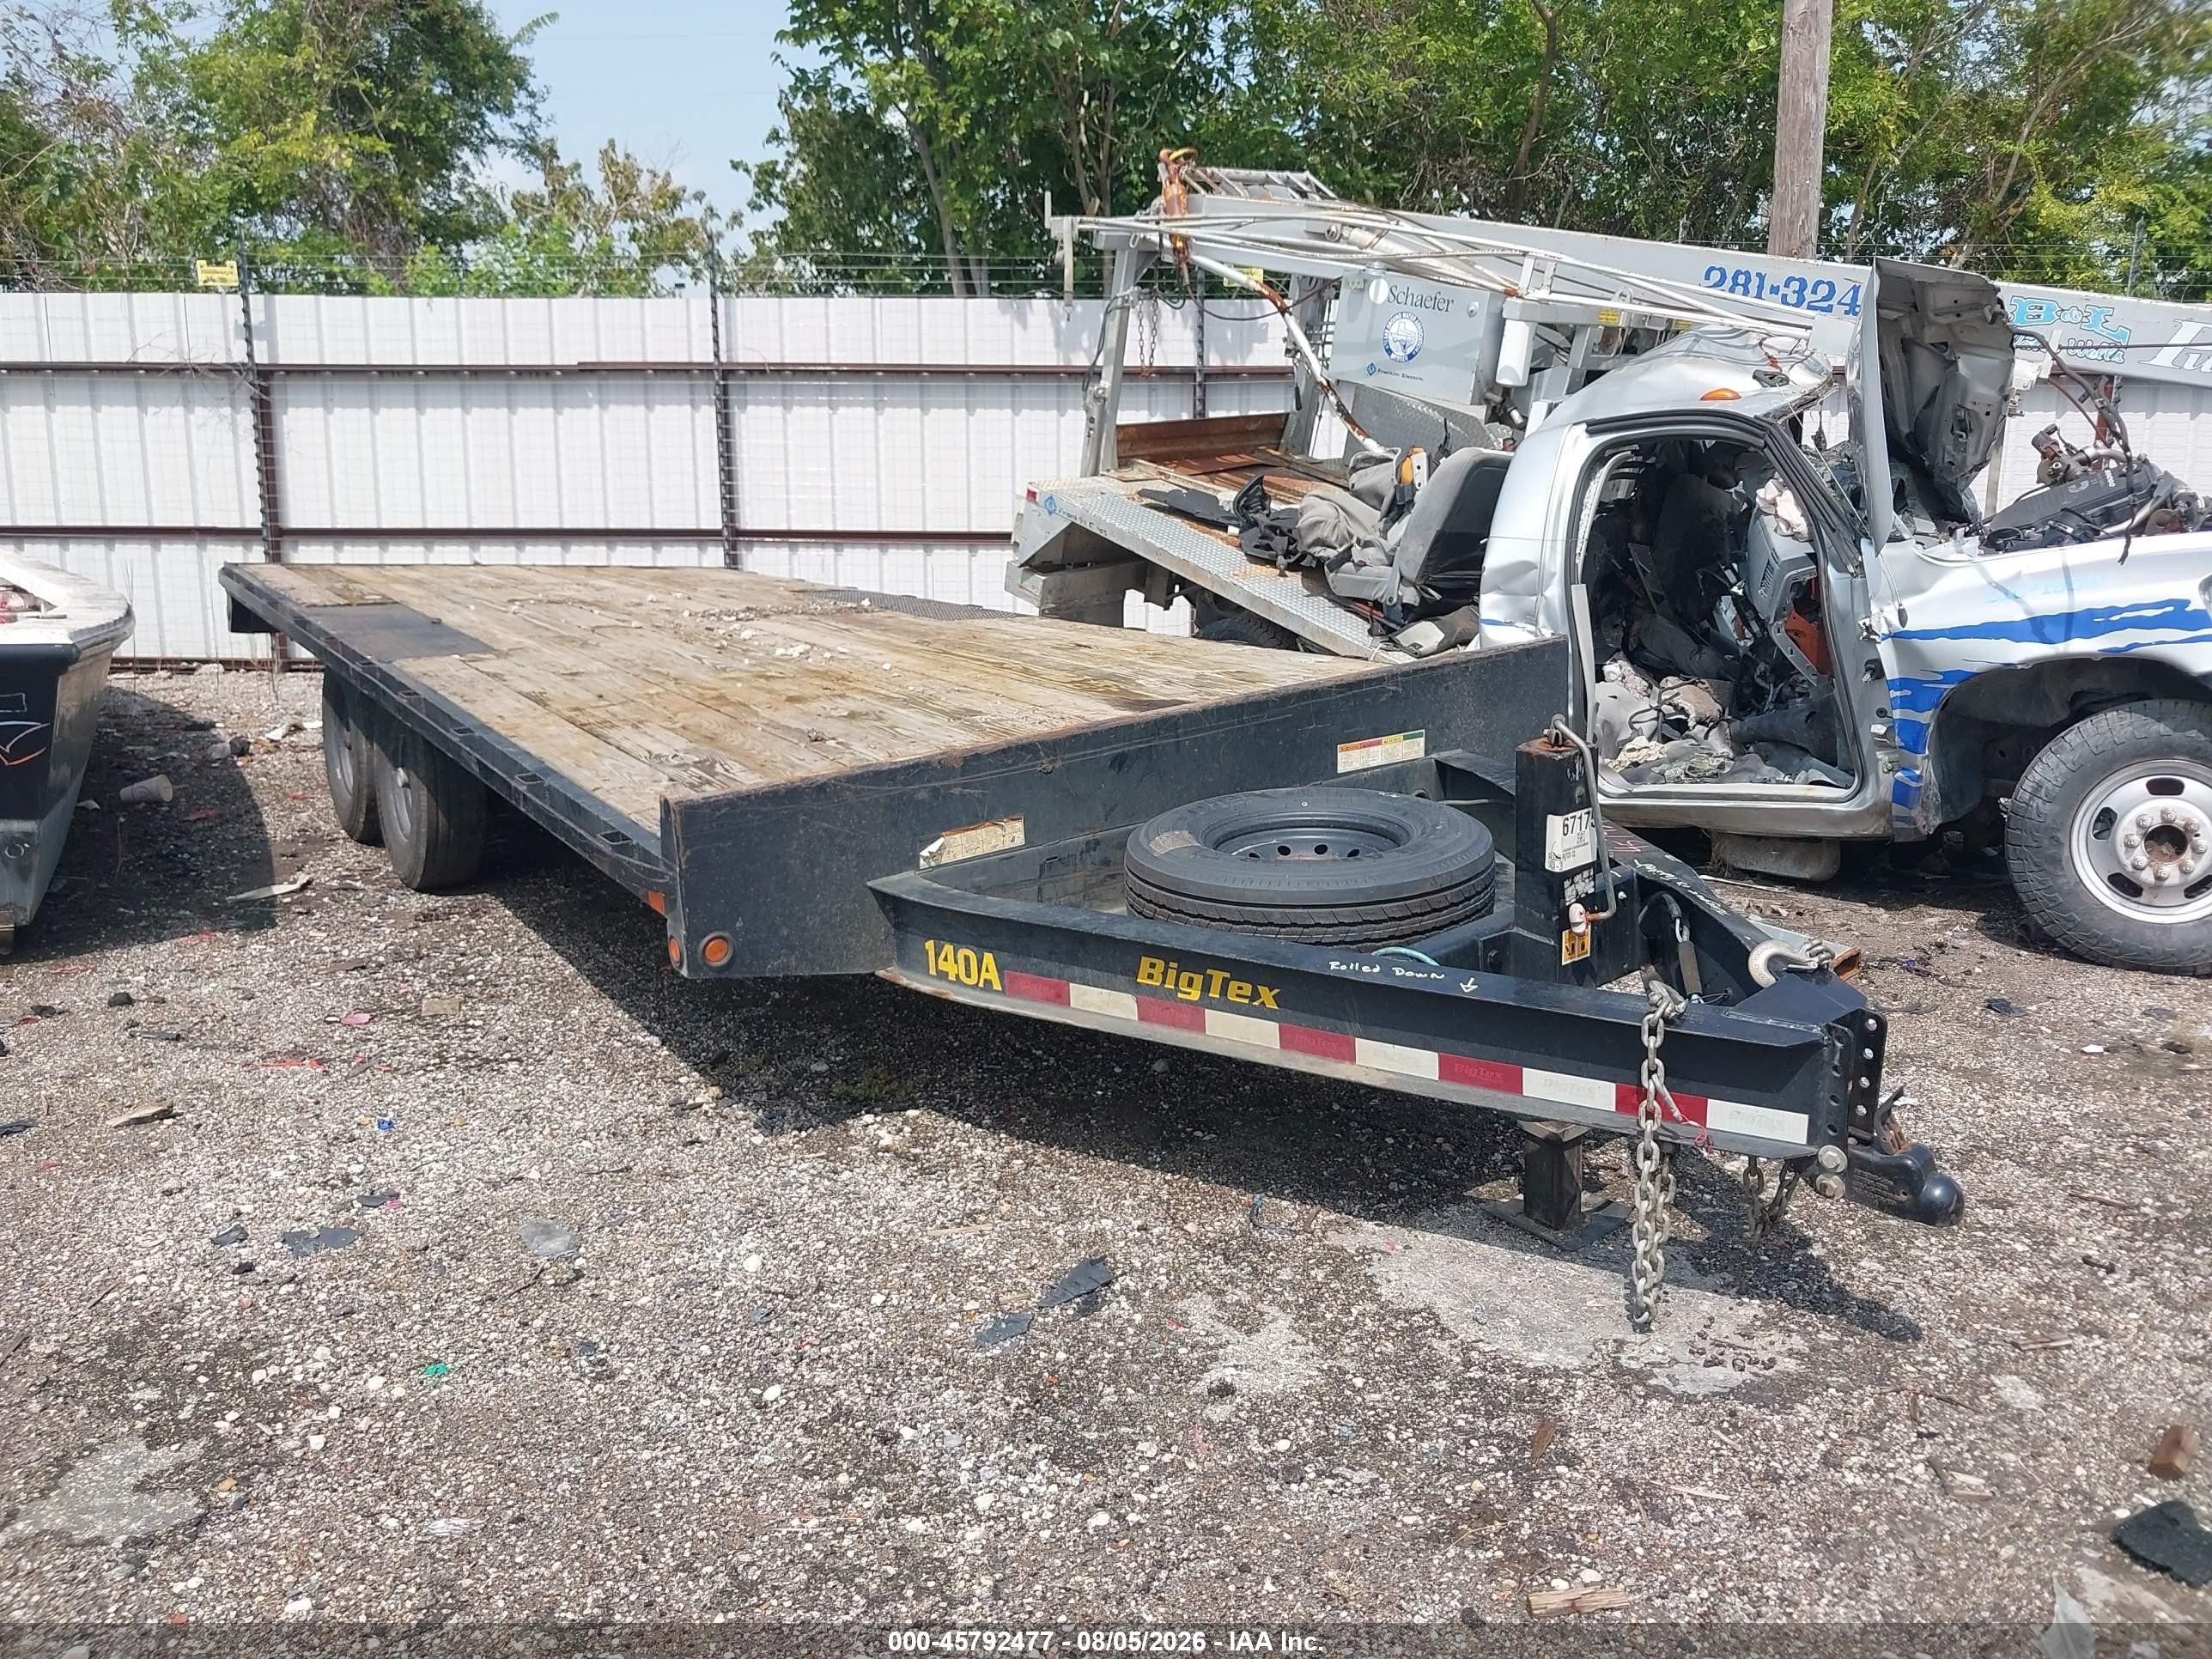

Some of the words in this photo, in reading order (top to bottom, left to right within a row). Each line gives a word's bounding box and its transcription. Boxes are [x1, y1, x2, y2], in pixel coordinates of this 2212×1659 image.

[1388, 284, 1455, 313] Schaefer
[925, 939, 1003, 991] 140A
[1136, 955, 1281, 1010] BigTex
[1329, 961, 1381, 973] Rolled
